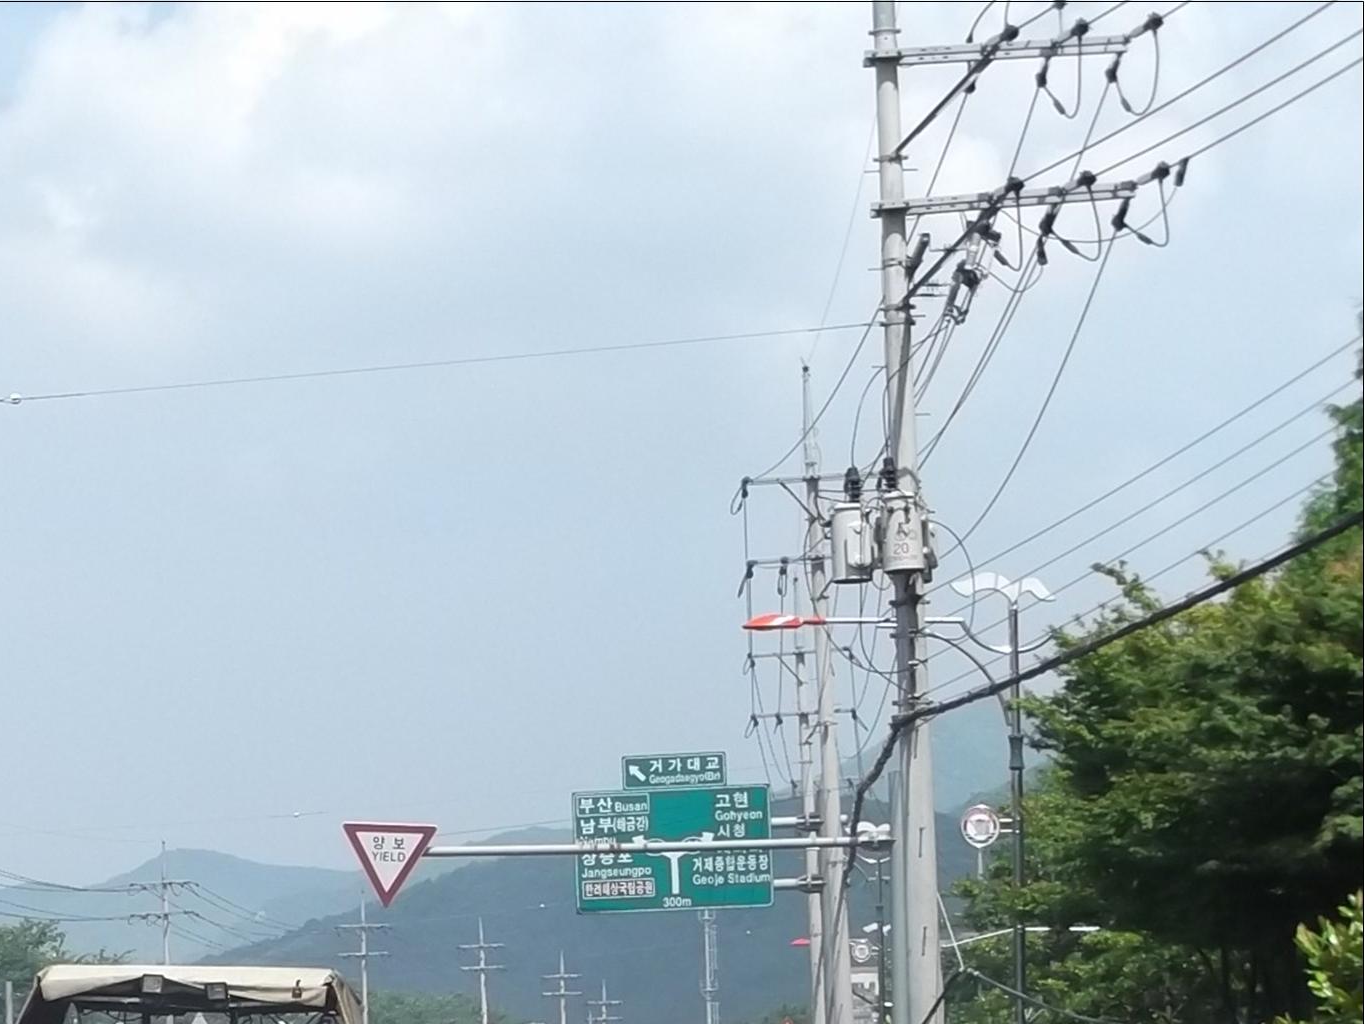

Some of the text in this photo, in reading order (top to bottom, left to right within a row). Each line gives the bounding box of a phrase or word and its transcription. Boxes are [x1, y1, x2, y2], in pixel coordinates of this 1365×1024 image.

[649, 756, 720, 773] 거가대교
[579, 797, 648, 814] 부산 Busan
[715, 791, 749, 808] 고현
[715, 810, 763, 822] Gohyeon
[717, 822, 746, 838] 시청
[373, 836, 406, 850] 양보
[372, 851, 406, 863] YIELD
[581, 866, 652, 879] Jangseungpo
[692, 872, 771, 886] Geoje Stadium
[662, 896, 692, 908] 300m
